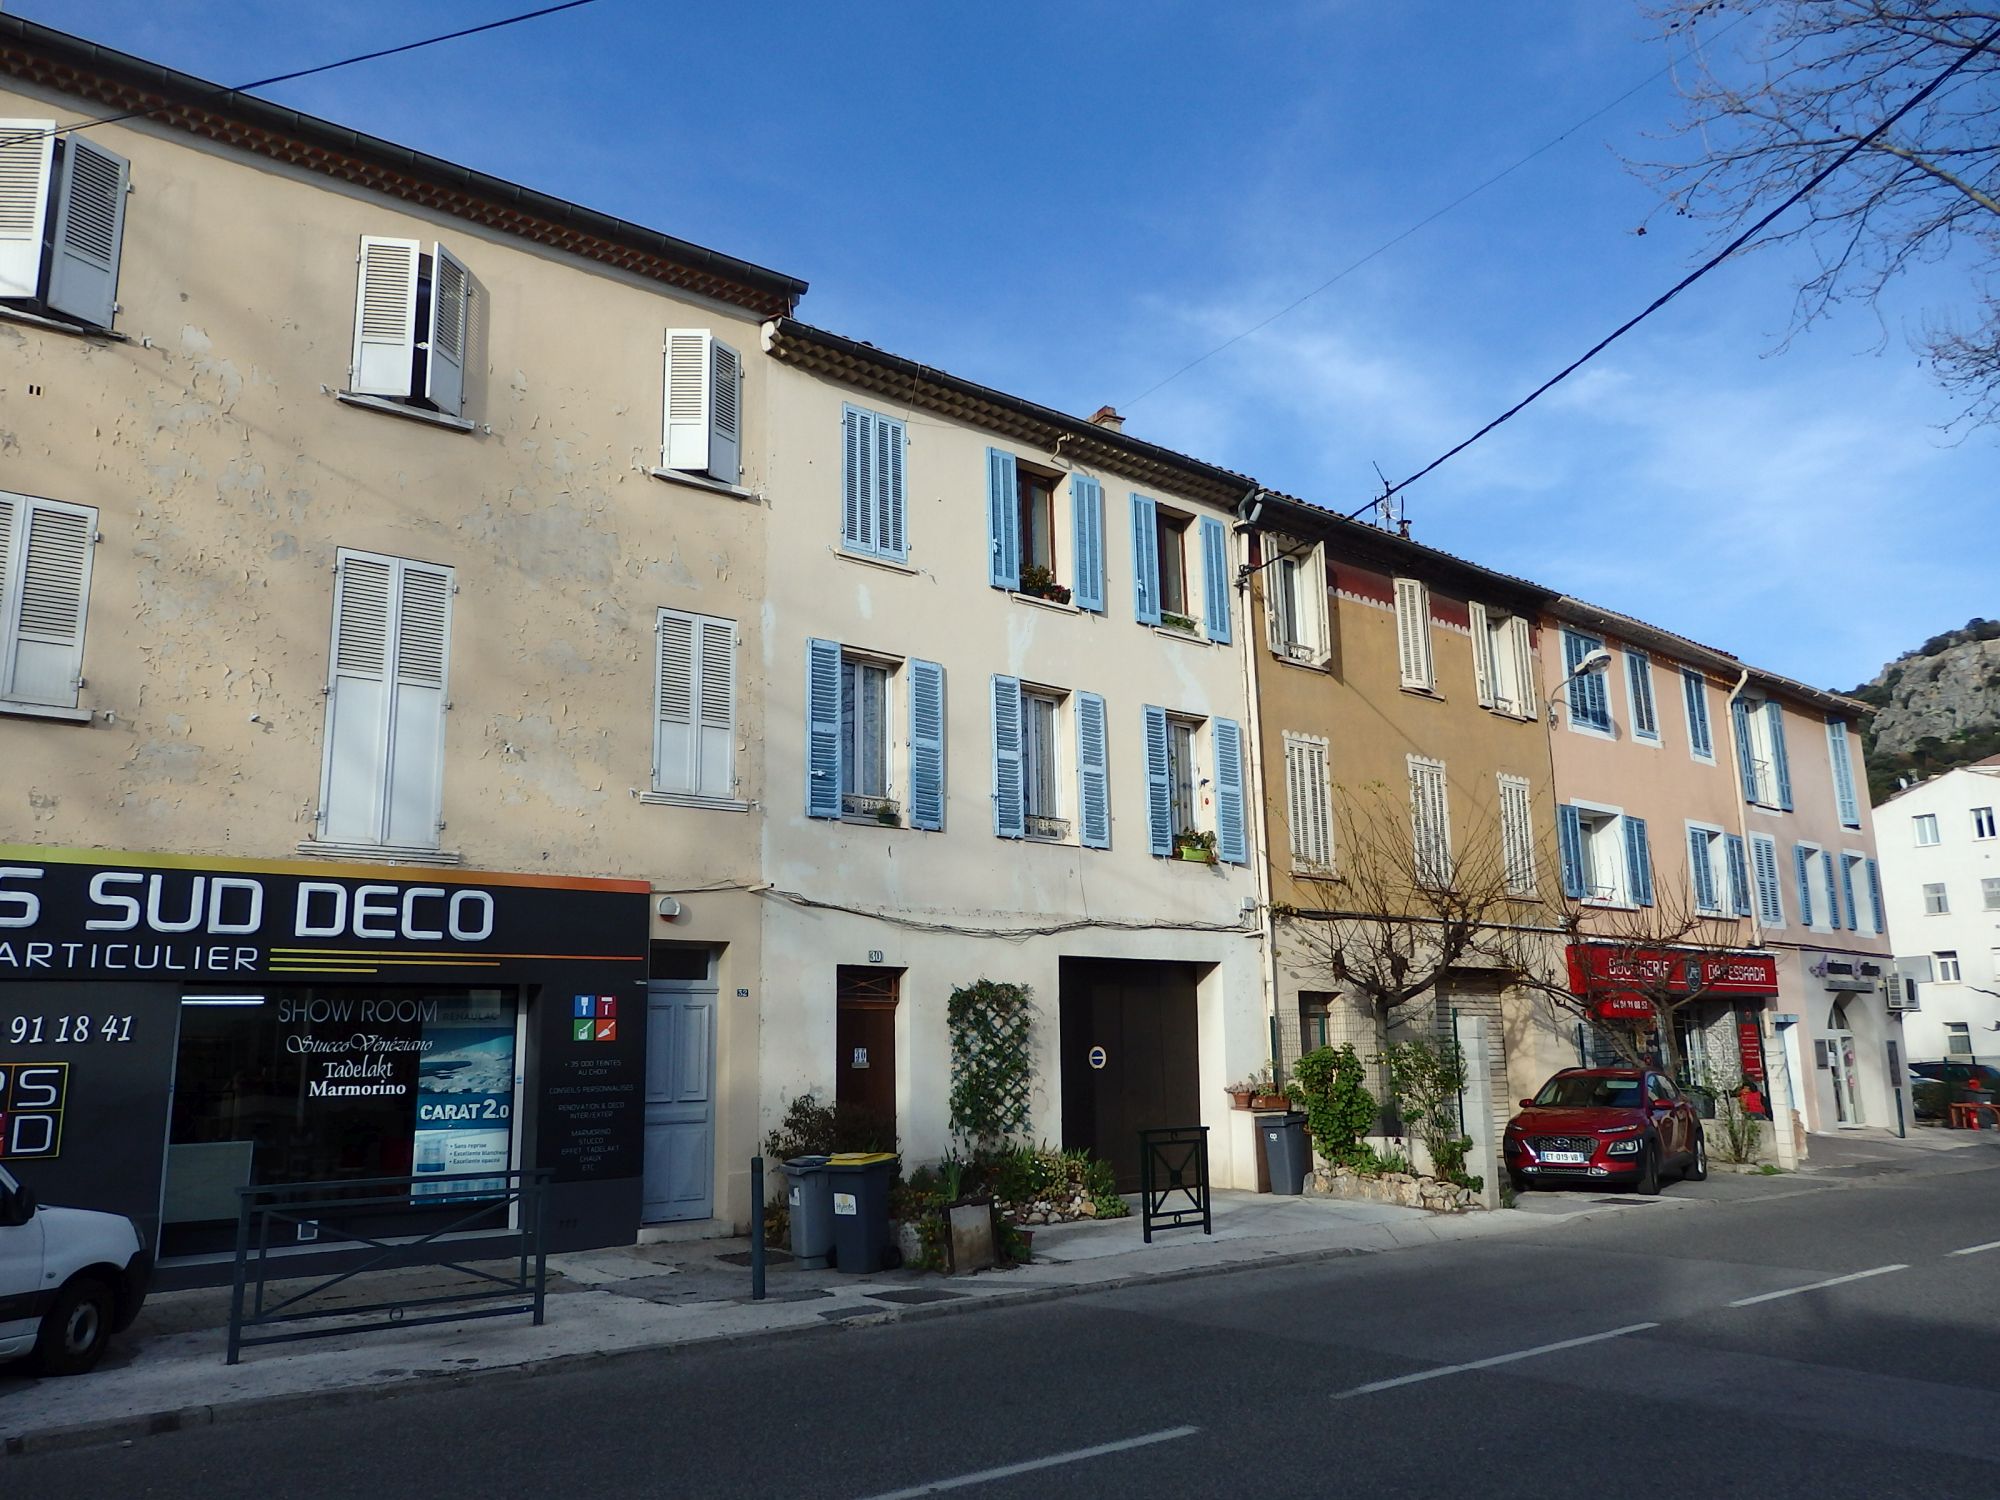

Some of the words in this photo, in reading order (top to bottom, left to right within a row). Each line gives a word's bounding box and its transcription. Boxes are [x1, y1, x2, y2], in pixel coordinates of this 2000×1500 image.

[85, 871, 264, 935] SUD
[294, 881, 495, 942] DECO
[0, 941, 259, 972] ARTICULIER
[869, 951, 883, 963] 30
[737, 989, 748, 997] 32
[278, 999, 355, 1023] SHOW
[360, 999, 438, 1023] ROOM
[10, 1015, 44, 1044] 91
[55, 1015, 90, 1043] 18
[101, 1014, 133, 1042] 41
[286, 1034, 351, 1054] Stucco
[322, 1054, 394, 1079] Tadelakt
[855, 1048, 867, 1063] 30
[308, 1080, 406, 1097] Marmorino
[420, 1103, 481, 1120] CARAT
[482, 1098, 510, 1119] 2.0
